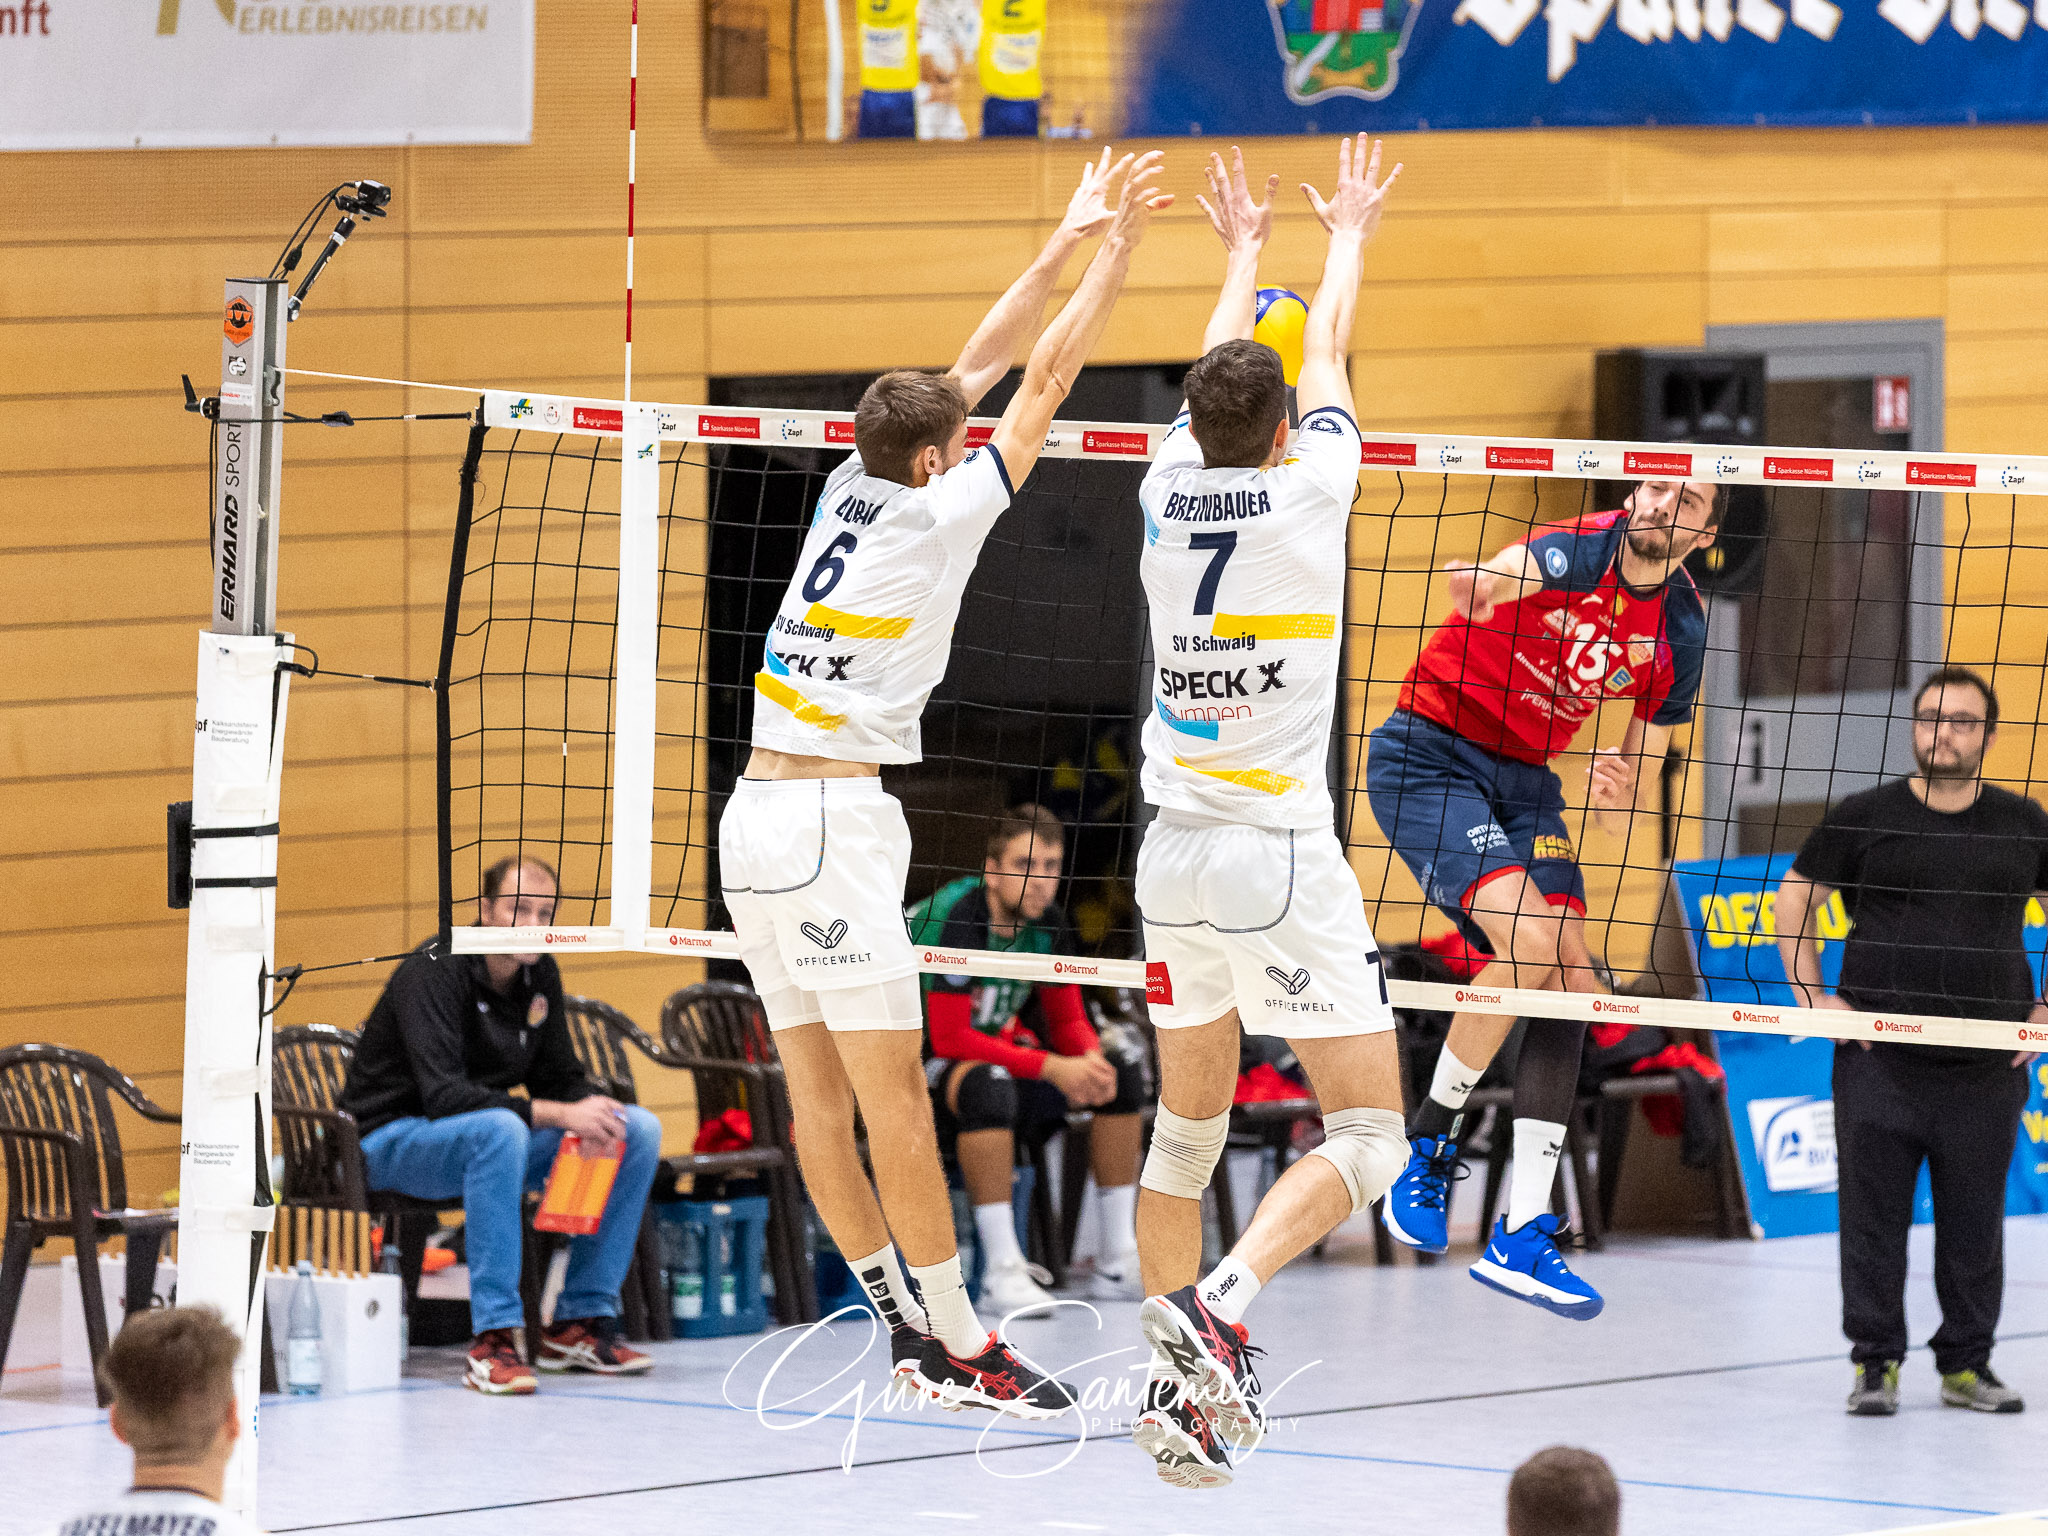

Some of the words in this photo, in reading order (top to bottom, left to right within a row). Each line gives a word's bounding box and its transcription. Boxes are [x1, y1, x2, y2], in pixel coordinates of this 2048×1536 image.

[238, 6, 488, 36] ERLEBNISREISEN
[661, 422, 677, 432] Zapf
[710, 424, 734, 434] Sparkasse
[735, 426, 756, 435] Nürnberg
[787, 428, 803, 437] Zapf
[1045, 438, 1061, 448] Zapf
[1096, 441, 1119, 450] Sparkasse
[1120, 442, 1144, 452] Nürnberg
[226, 422, 242, 487] SPORT
[1363, 451, 1387, 460] Sparkasse
[1388, 452, 1412, 462] Nürnberg
[1446, 454, 1462, 464] Zapf
[1499, 456, 1524, 466] Sparkasse
[1524, 458, 1549, 467] Nürnberg
[1583, 460, 1600, 469] Zapf
[1637, 462, 1662, 471] Sparkasse
[1663, 463, 1687, 472] Nürnberg
[1723, 464, 1740, 474] Zapf
[1777, 468, 1803, 477] Sparkasse
[1804, 468, 1829, 478] Nürnberg
[1864, 470, 1881, 480] Zapf
[1920, 472, 1946, 482] Sparkasse
[1947, 474, 1972, 484] Nürnberg
[2008, 475, 2025, 485] Zapf
[1163, 490, 1272, 522] BREINBAUER
[220, 494, 239, 621] ERHARD
[801, 531, 858, 604] 6
[1189, 530, 1238, 616] 7
[775, 614, 786, 635] SV
[784, 619, 836, 644] Schwaig
[1173, 635, 1188, 657] SV
[1192, 630, 1257, 656] Schwaig
[1565, 622, 1624, 682] 15
[1160, 667, 1250, 701] SPECK
[554, 934, 587, 944] Marmot
[679, 937, 712, 948] Marmot
[796, 952, 872, 967] OFFICEWELT
[933, 954, 968, 966] Marmot
[1064, 964, 1099, 975] Marmot
[1465, 992, 1502, 1004] Marmot
[1265, 998, 1335, 1013] OFFICEWELT
[1603, 1002, 1640, 1014] Marmot
[1743, 1012, 1780, 1024] Marmot
[1885, 1021, 1923, 1034] Marmot
[1219, 1273, 1239, 1297] CRAFT
